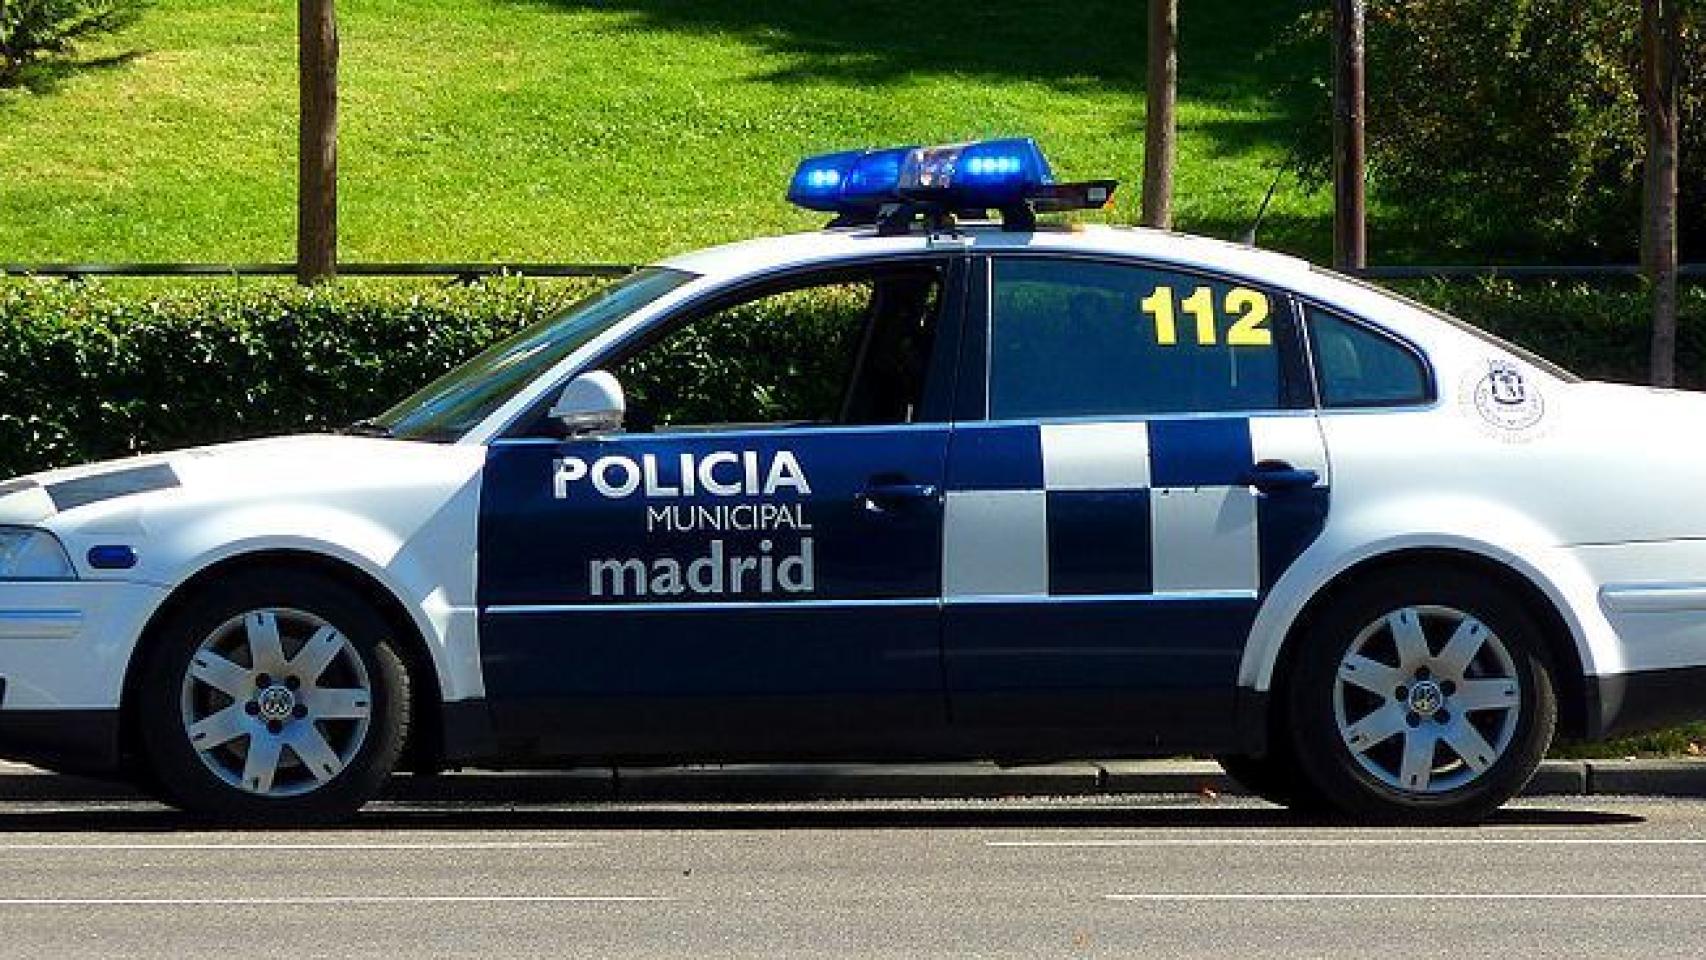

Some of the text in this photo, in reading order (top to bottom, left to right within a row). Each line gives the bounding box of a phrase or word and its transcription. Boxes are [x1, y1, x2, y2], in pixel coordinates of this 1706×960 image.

[1142, 286, 1272, 345] 112
[553, 450, 812, 499] POLICIA
[647, 504, 812, 531] MUNICIPAL
[589, 537, 815, 596] madrid
